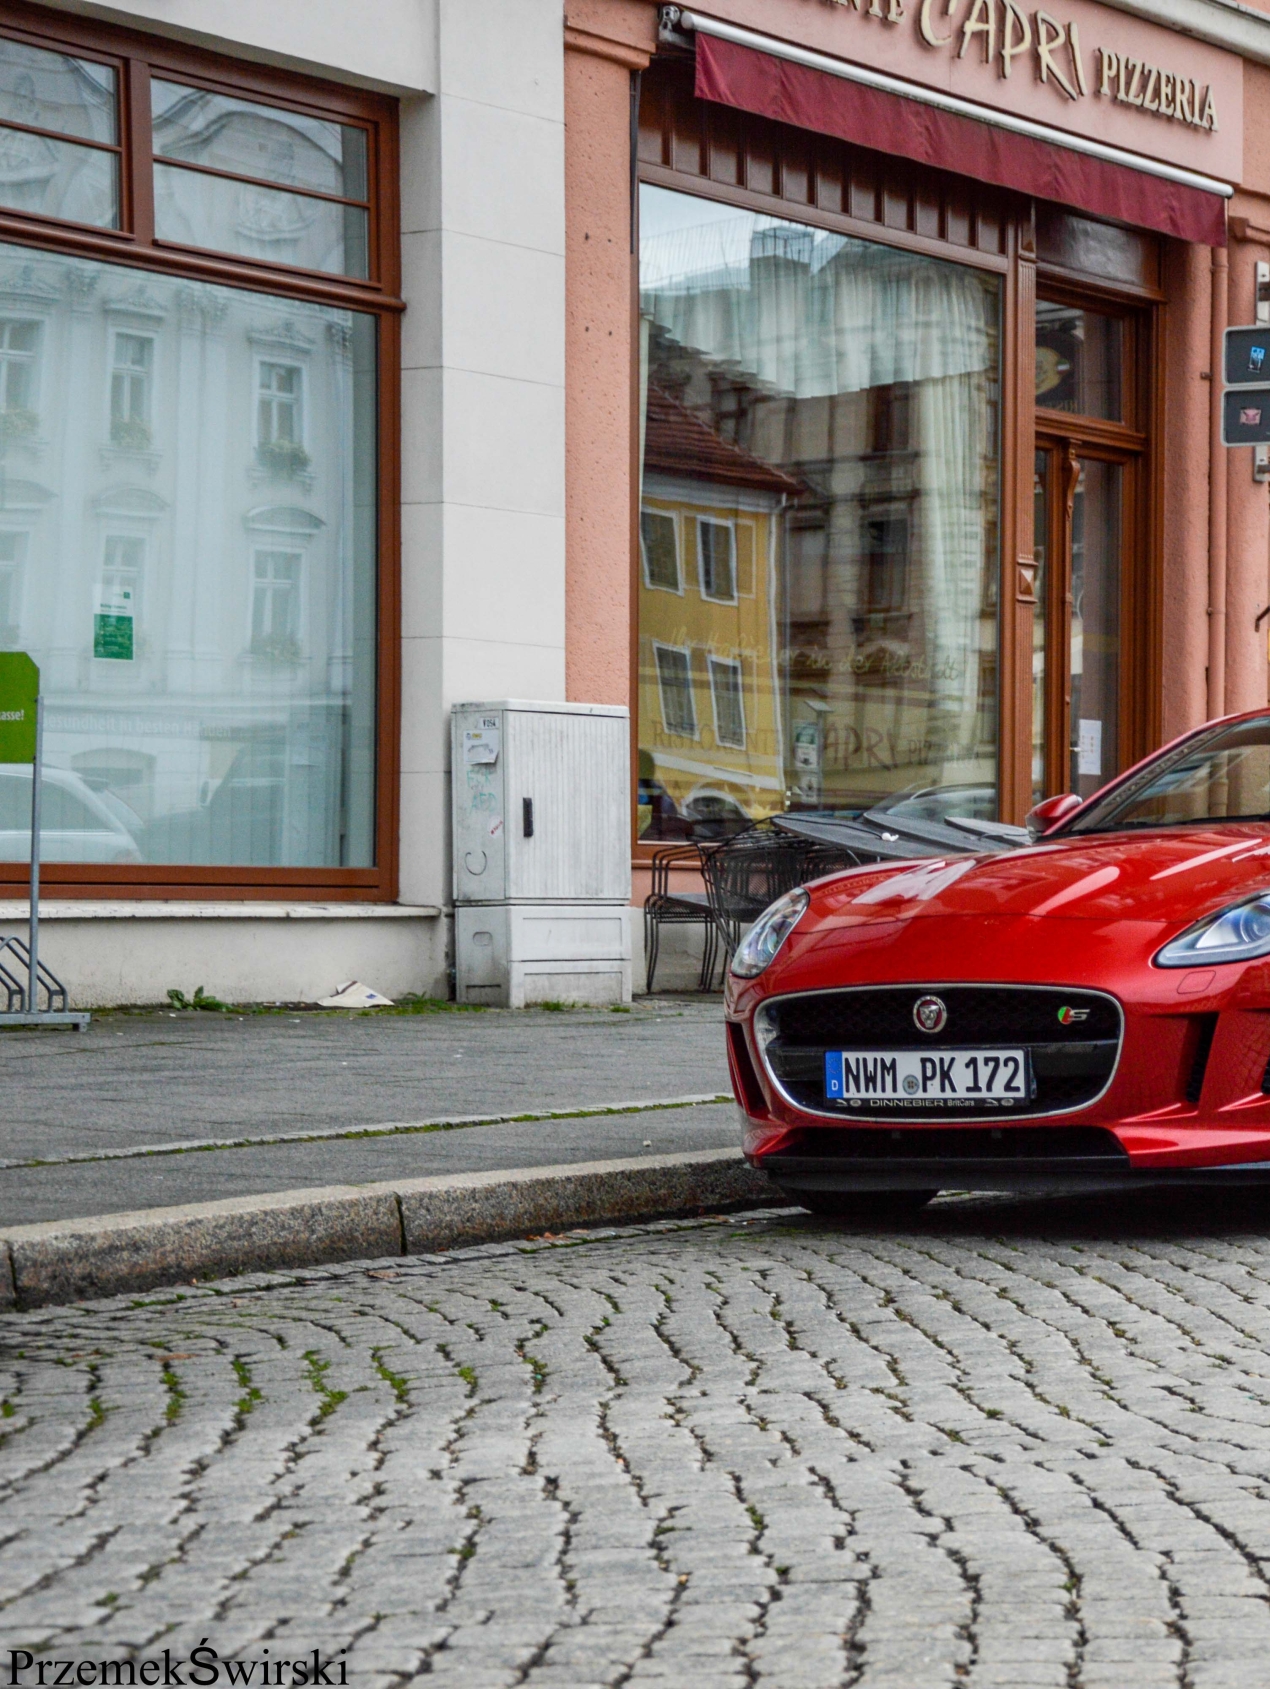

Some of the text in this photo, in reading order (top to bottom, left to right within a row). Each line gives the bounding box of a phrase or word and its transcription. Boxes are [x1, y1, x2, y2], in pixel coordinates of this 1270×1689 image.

[1100, 47, 1218, 132] PIZZERIA
[844, 1056, 1021, 1093] NWM PK 172
[870, 1099, 944, 1107] DINNEBIER
